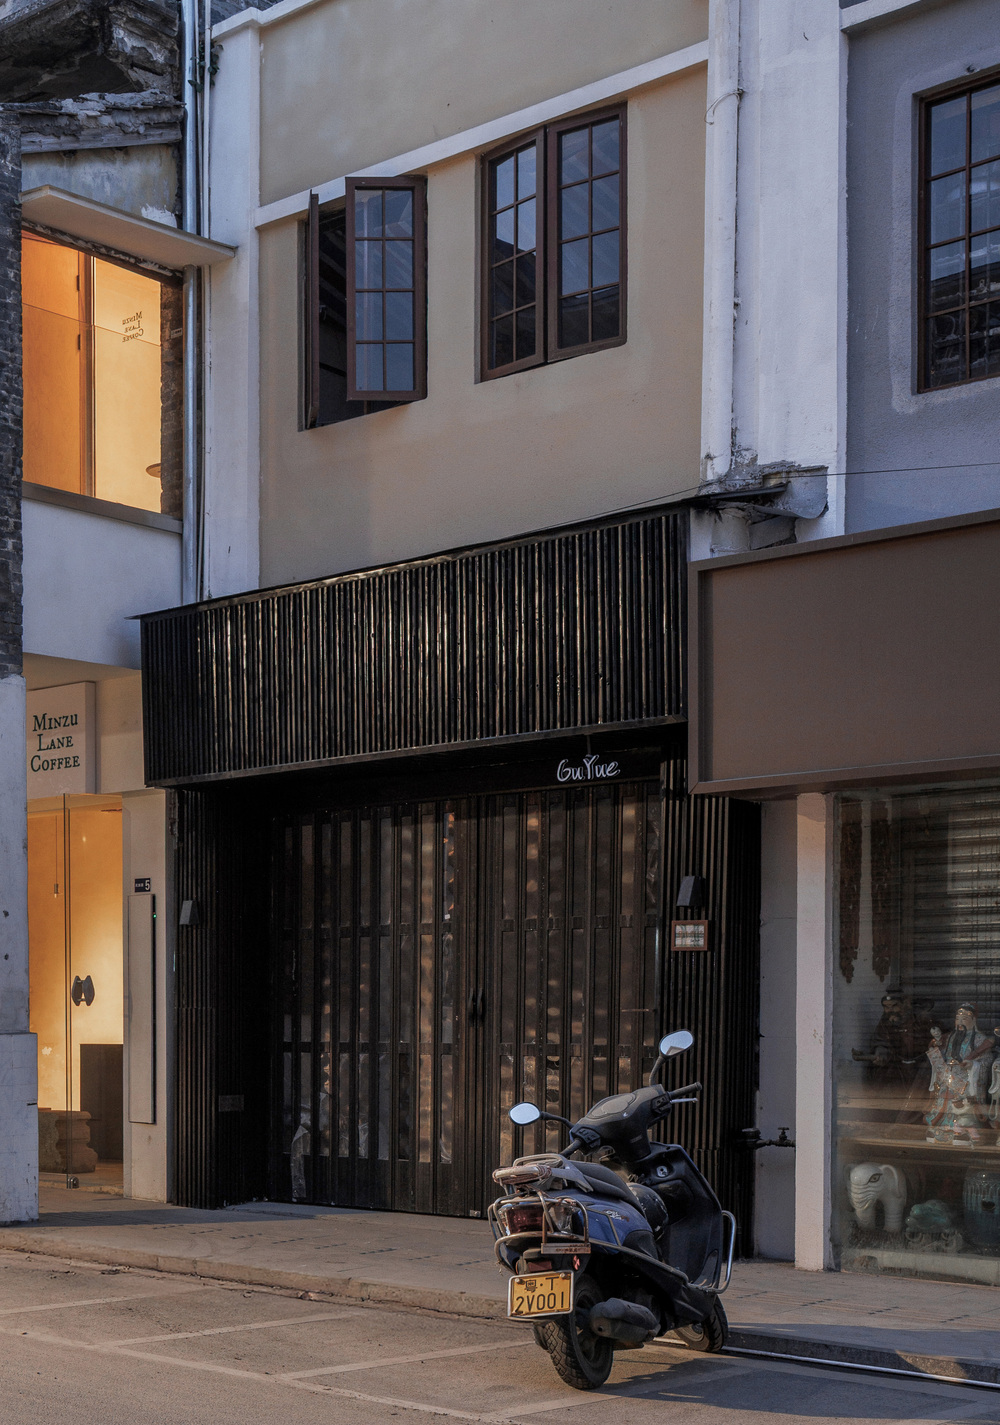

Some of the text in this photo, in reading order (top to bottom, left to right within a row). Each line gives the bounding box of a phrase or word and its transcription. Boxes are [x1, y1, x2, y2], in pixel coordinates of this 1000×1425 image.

[557, 754, 621, 782] GuYue
[145, 879, 150, 891] 5
[515, 1292, 564, 1314] 2V001
